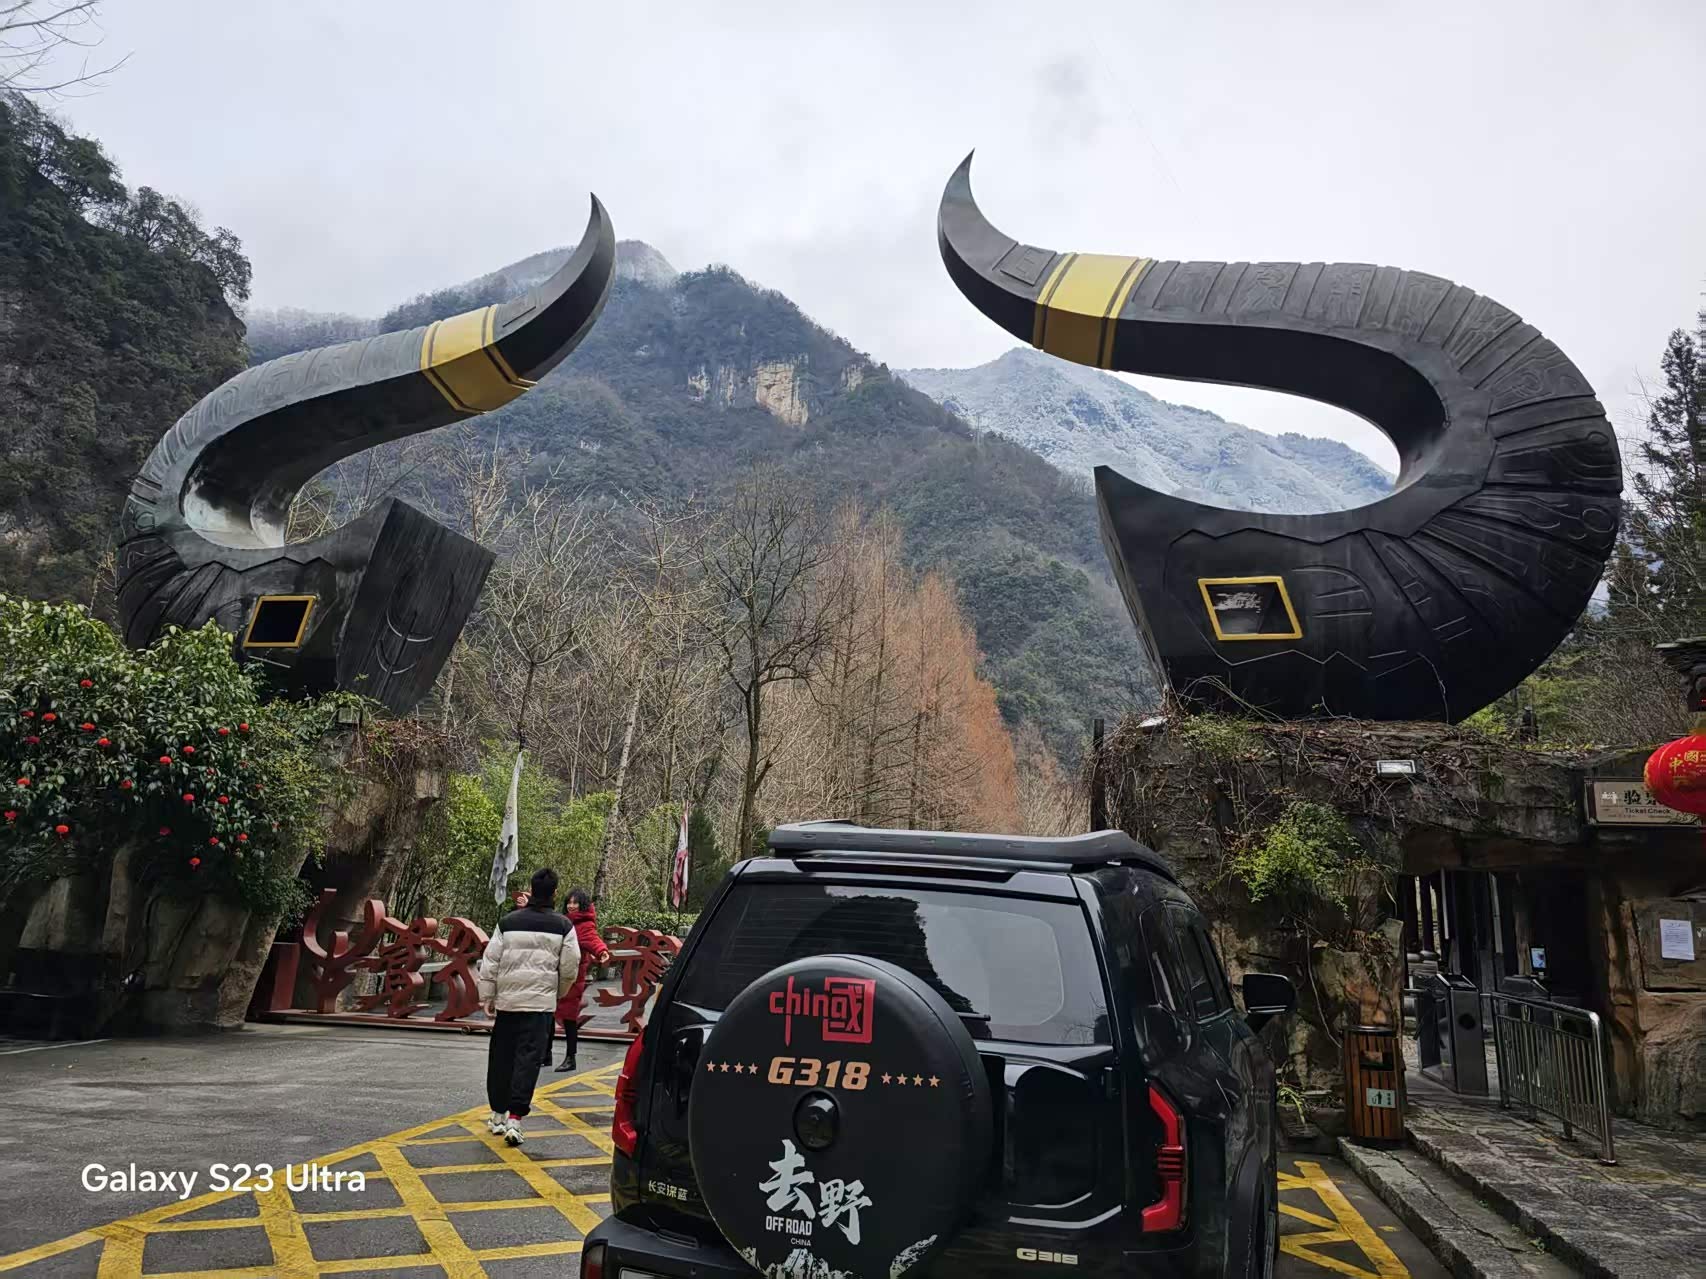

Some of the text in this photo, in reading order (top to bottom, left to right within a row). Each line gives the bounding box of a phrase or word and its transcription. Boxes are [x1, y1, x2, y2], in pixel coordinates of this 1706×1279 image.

[767, 1056, 871, 1090] G318
[648, 1179, 689, 1201] 长安深蓝
[759, 1139, 873, 1246] 去野
[765, 1215, 813, 1236] OFF ROAD
[790, 1237, 812, 1247] CHINA
[1016, 1247, 1078, 1265] G318
